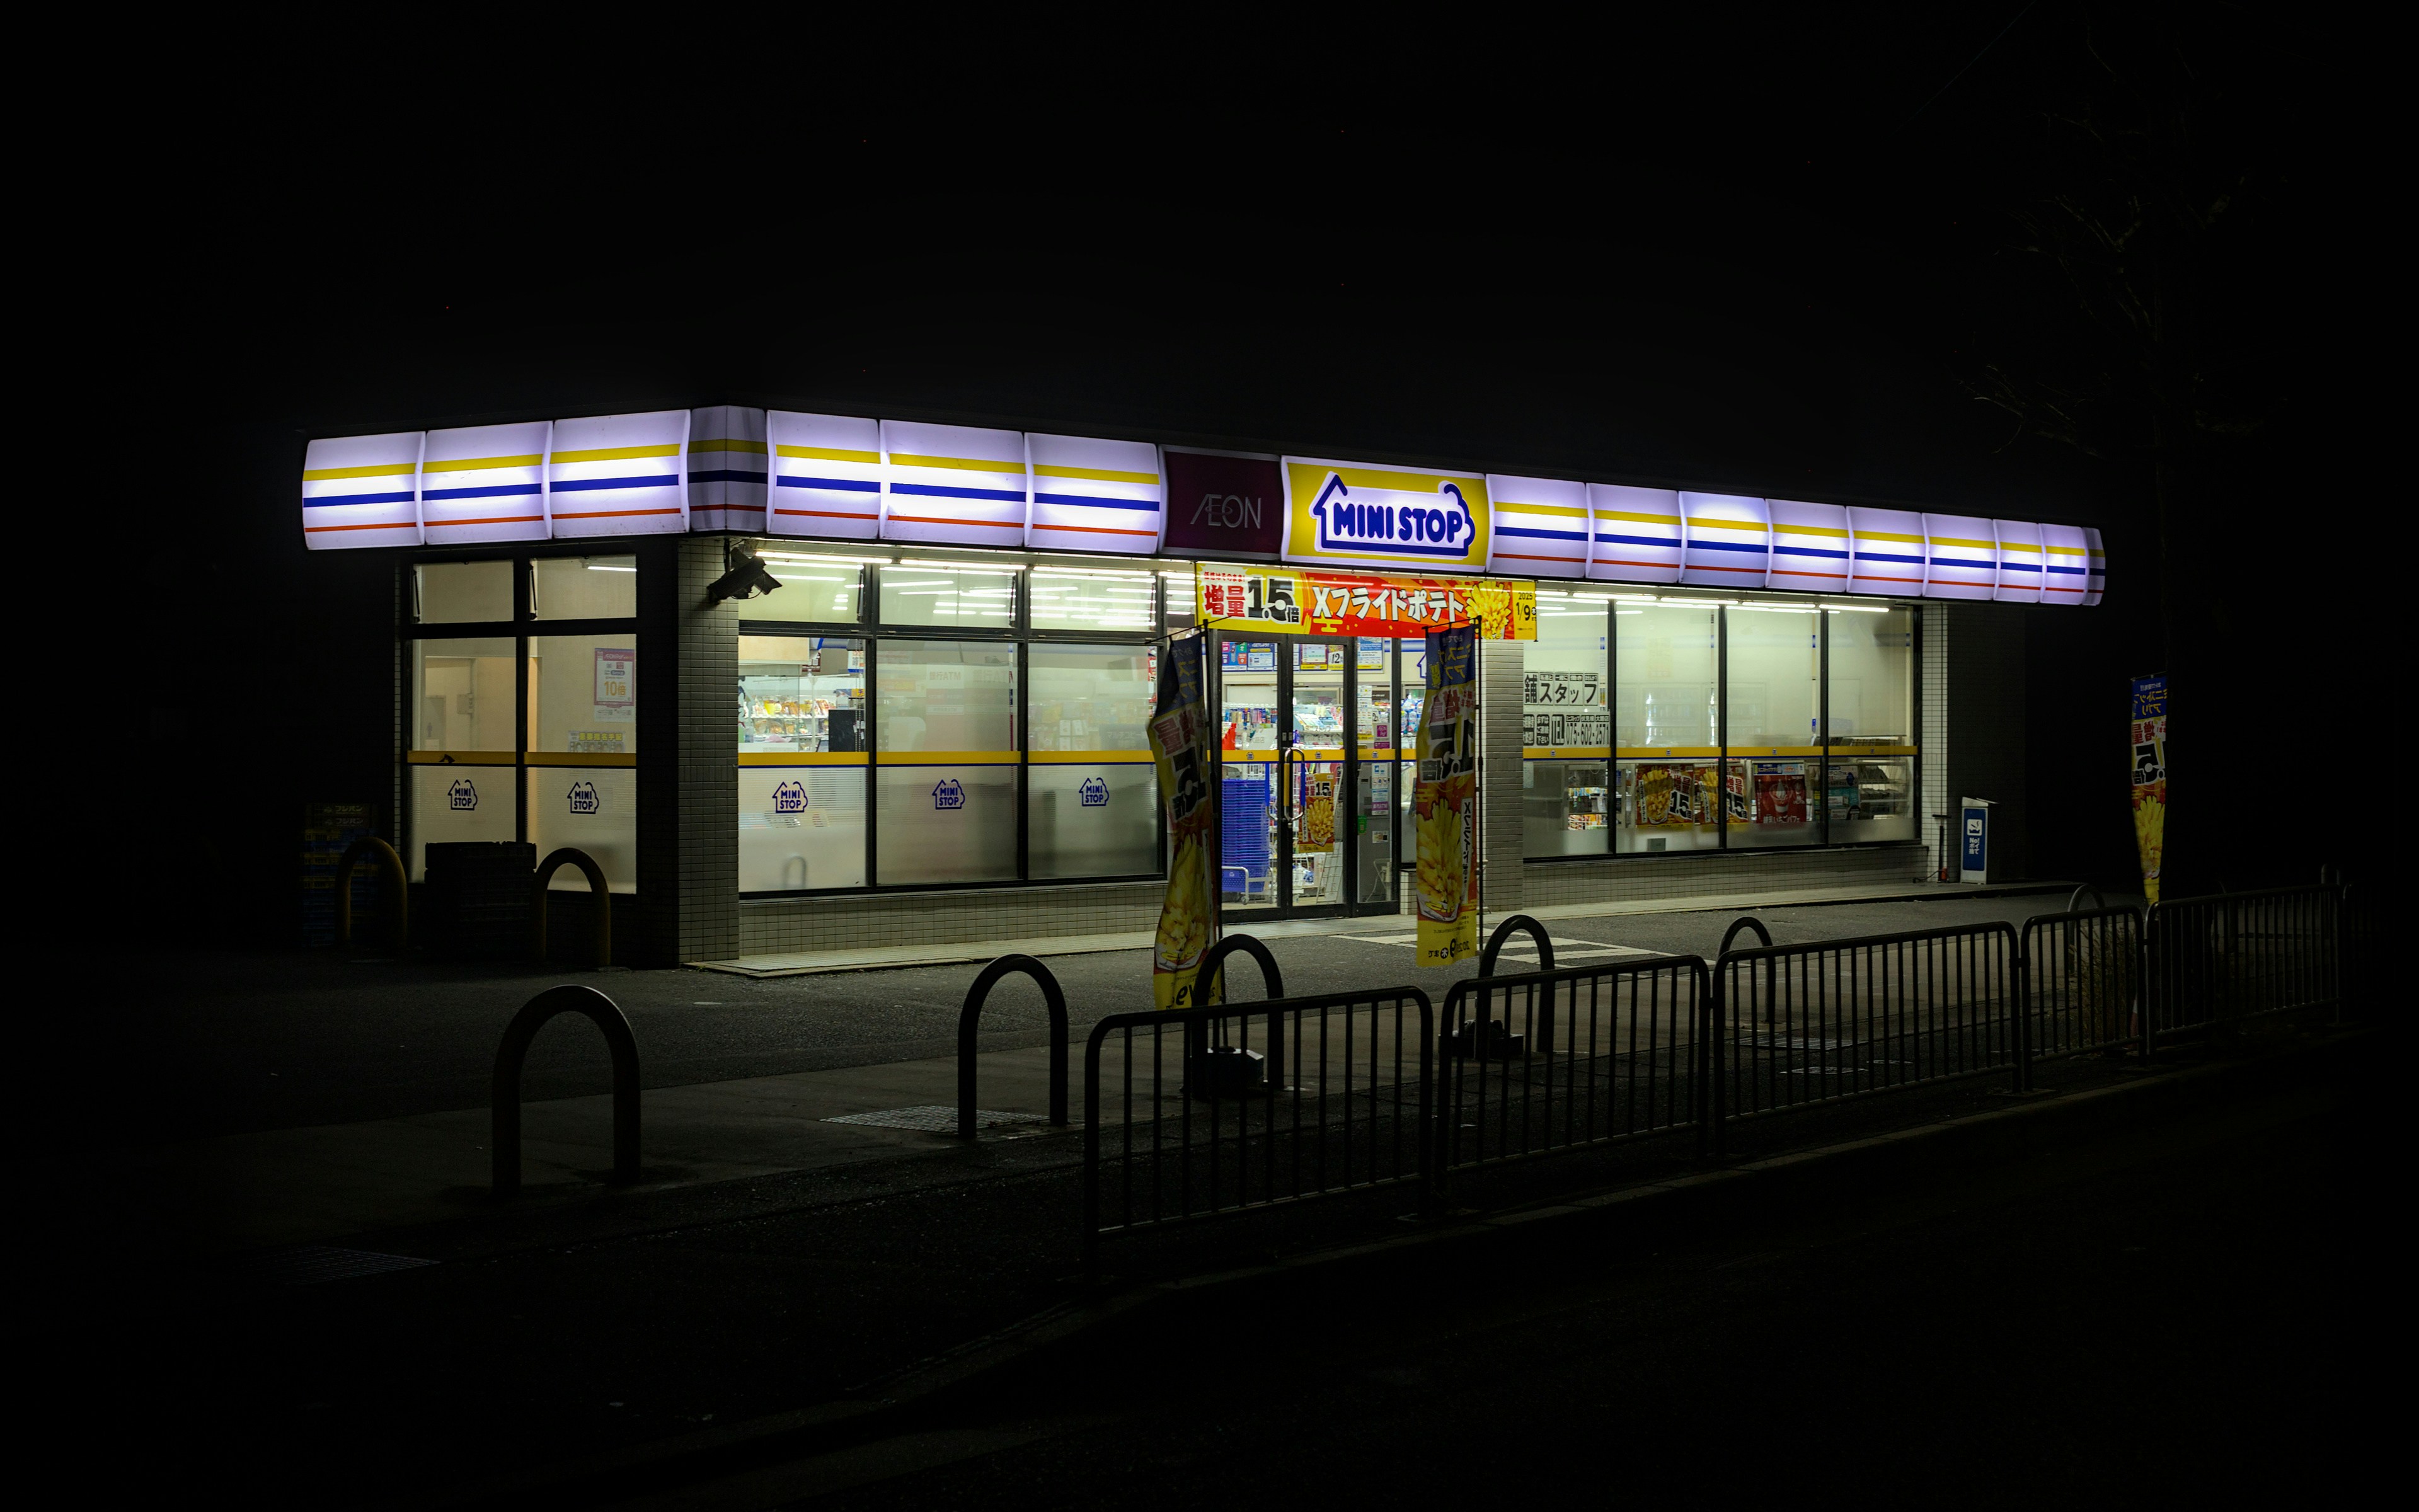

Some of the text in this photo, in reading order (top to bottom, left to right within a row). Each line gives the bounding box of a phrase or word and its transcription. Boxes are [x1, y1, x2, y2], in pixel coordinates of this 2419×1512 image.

[1333, 502, 1462, 543] MINI STOP
[1312, 586, 1464, 622] Xフライドポテト
[1566, 723, 1609, 745] 075-602-2571
[455, 788, 471, 796] MINI
[575, 791, 592, 799] MINI
[781, 790, 800, 799] MINI
[940, 788, 958, 796] MINI
[454, 798, 472, 806] STOP
[939, 797, 958, 806] STOP
[1085, 794, 1103, 803] STOP
[574, 801, 592, 810] STOP
[780, 800, 801, 809] STOP
